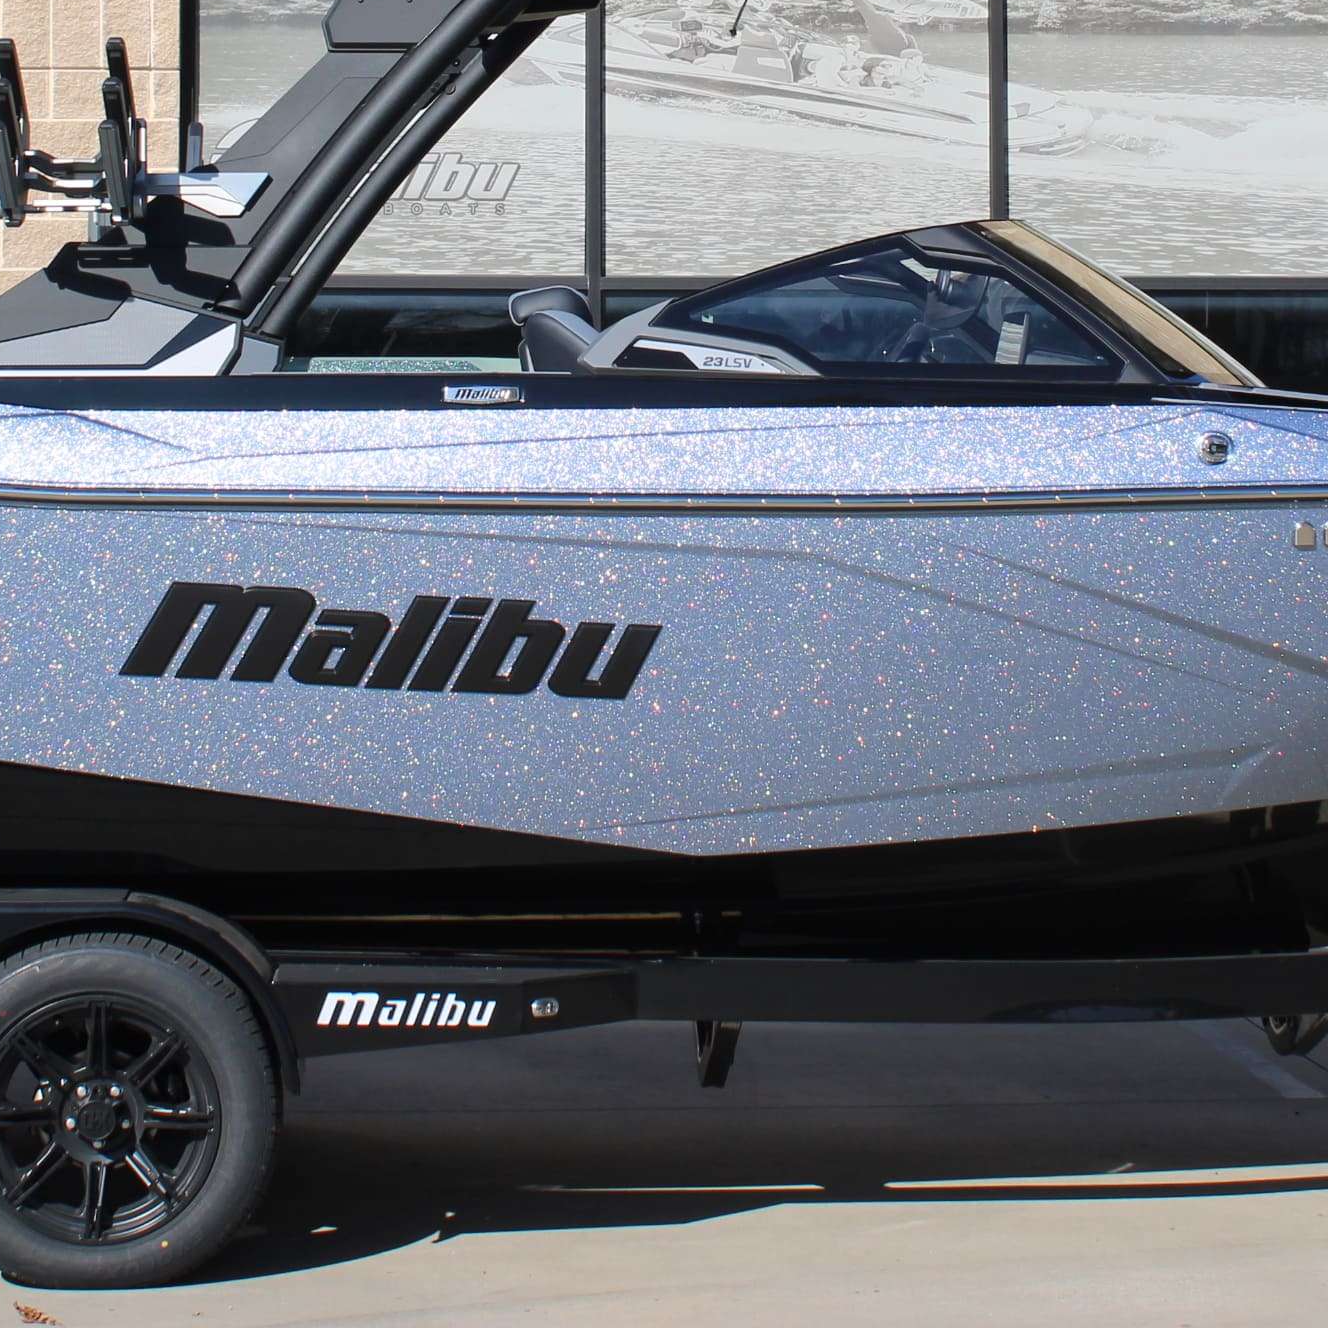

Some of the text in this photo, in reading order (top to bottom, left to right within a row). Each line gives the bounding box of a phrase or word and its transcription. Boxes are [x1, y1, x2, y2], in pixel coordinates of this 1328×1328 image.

[382, 202, 507, 216] BOATS
[702, 355, 754, 370] 23LSV
[119, 580, 663, 701] Malibu
[317, 990, 498, 1029] Malibu
